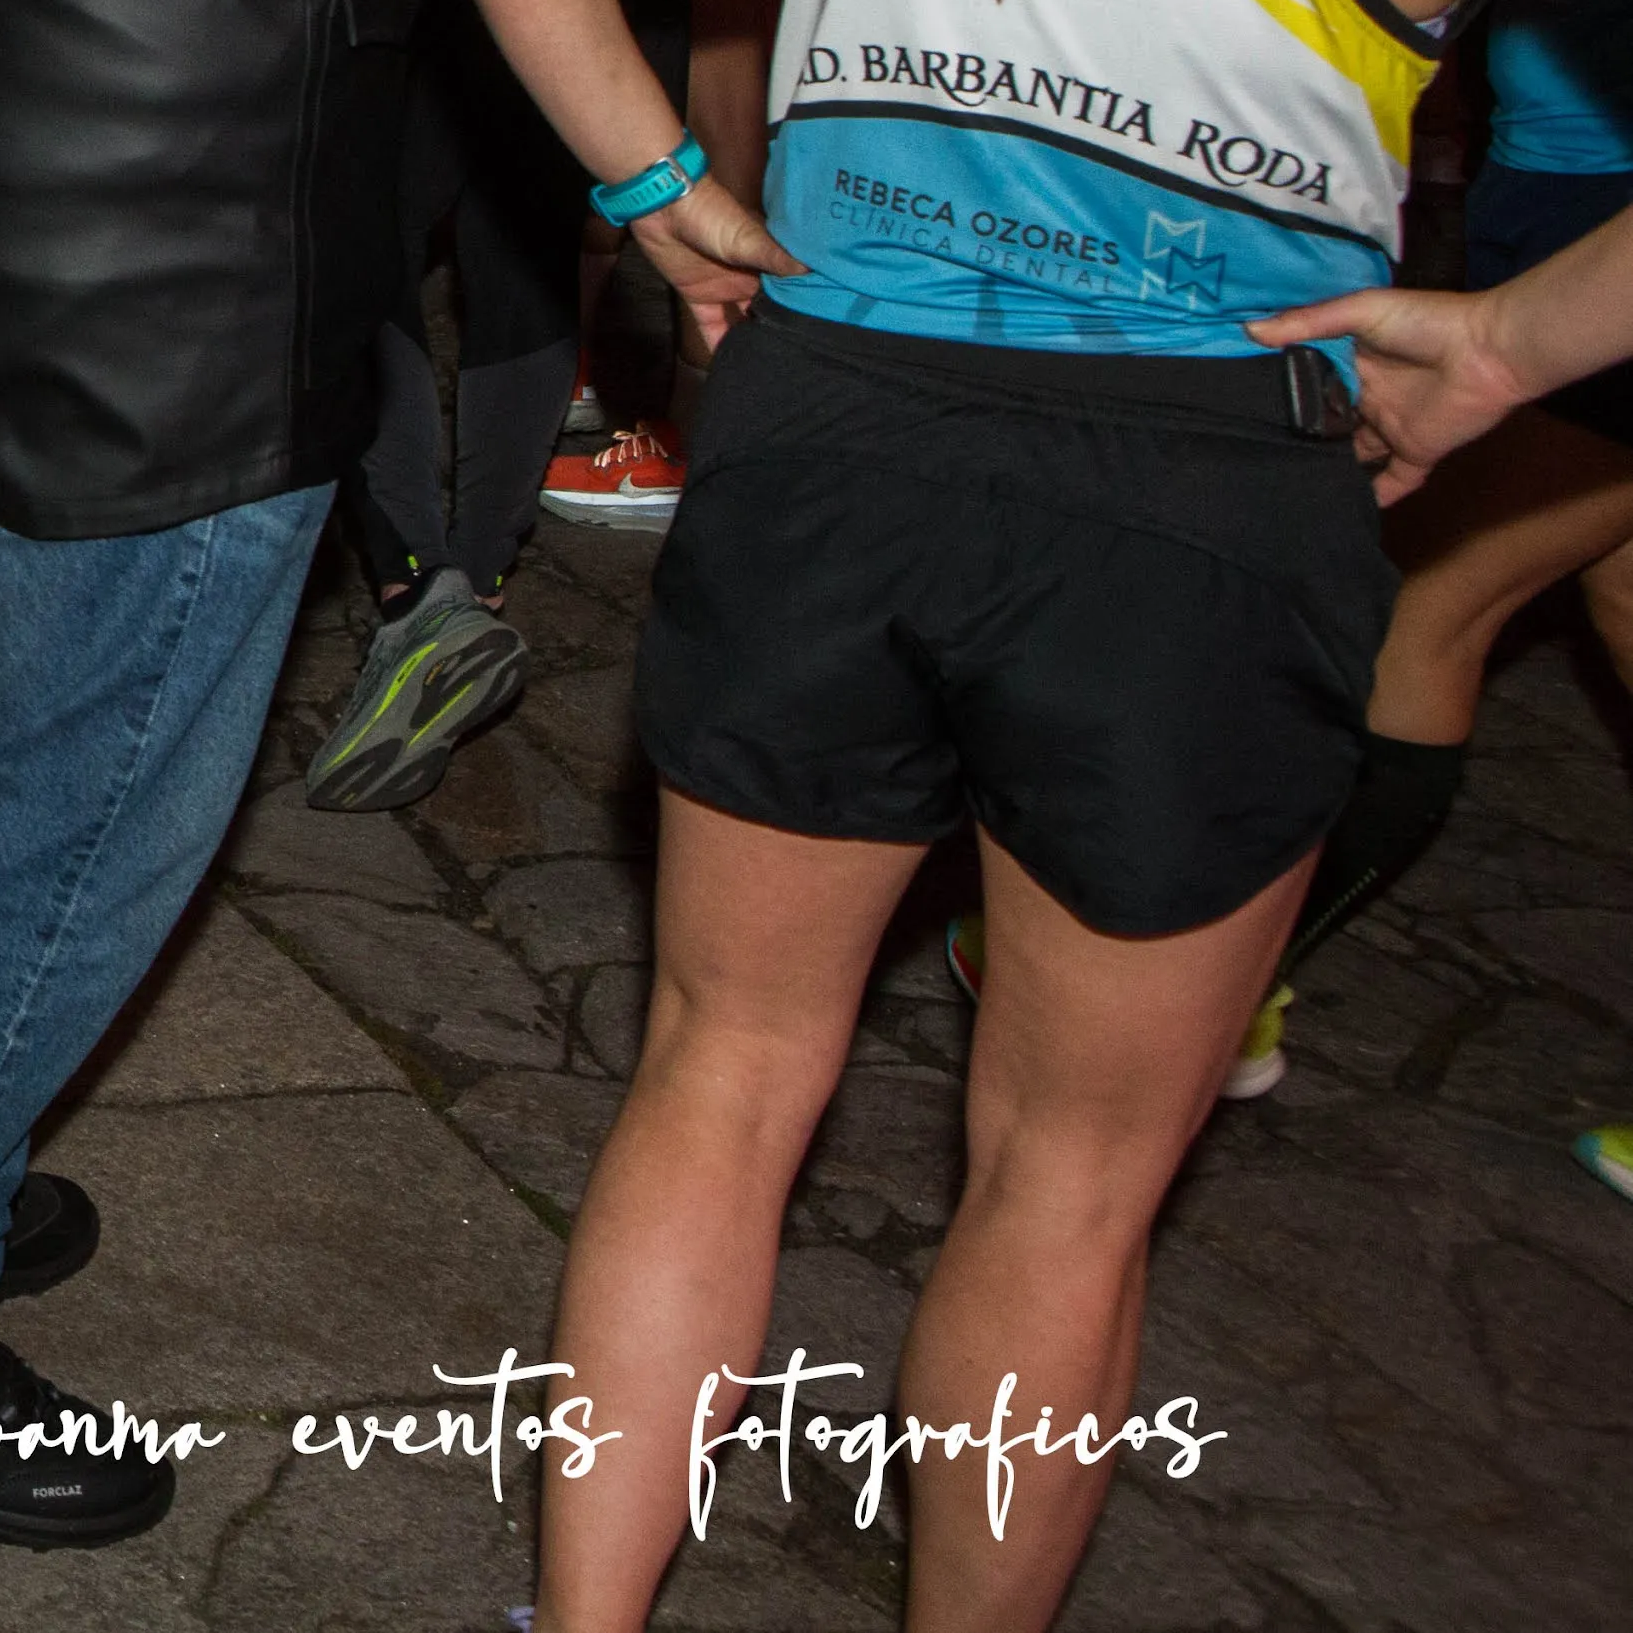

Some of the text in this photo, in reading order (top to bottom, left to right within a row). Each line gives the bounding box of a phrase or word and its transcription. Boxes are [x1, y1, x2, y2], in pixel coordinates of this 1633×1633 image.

[861, 44, 1156, 146] BARBANTIA
[1177, 118, 1333, 204] RODA
[834, 169, 1121, 267] REBECA OZORES
[975, 244, 1116, 294] DENTAL
[32, 1485, 83, 1498] FORCLAZ
